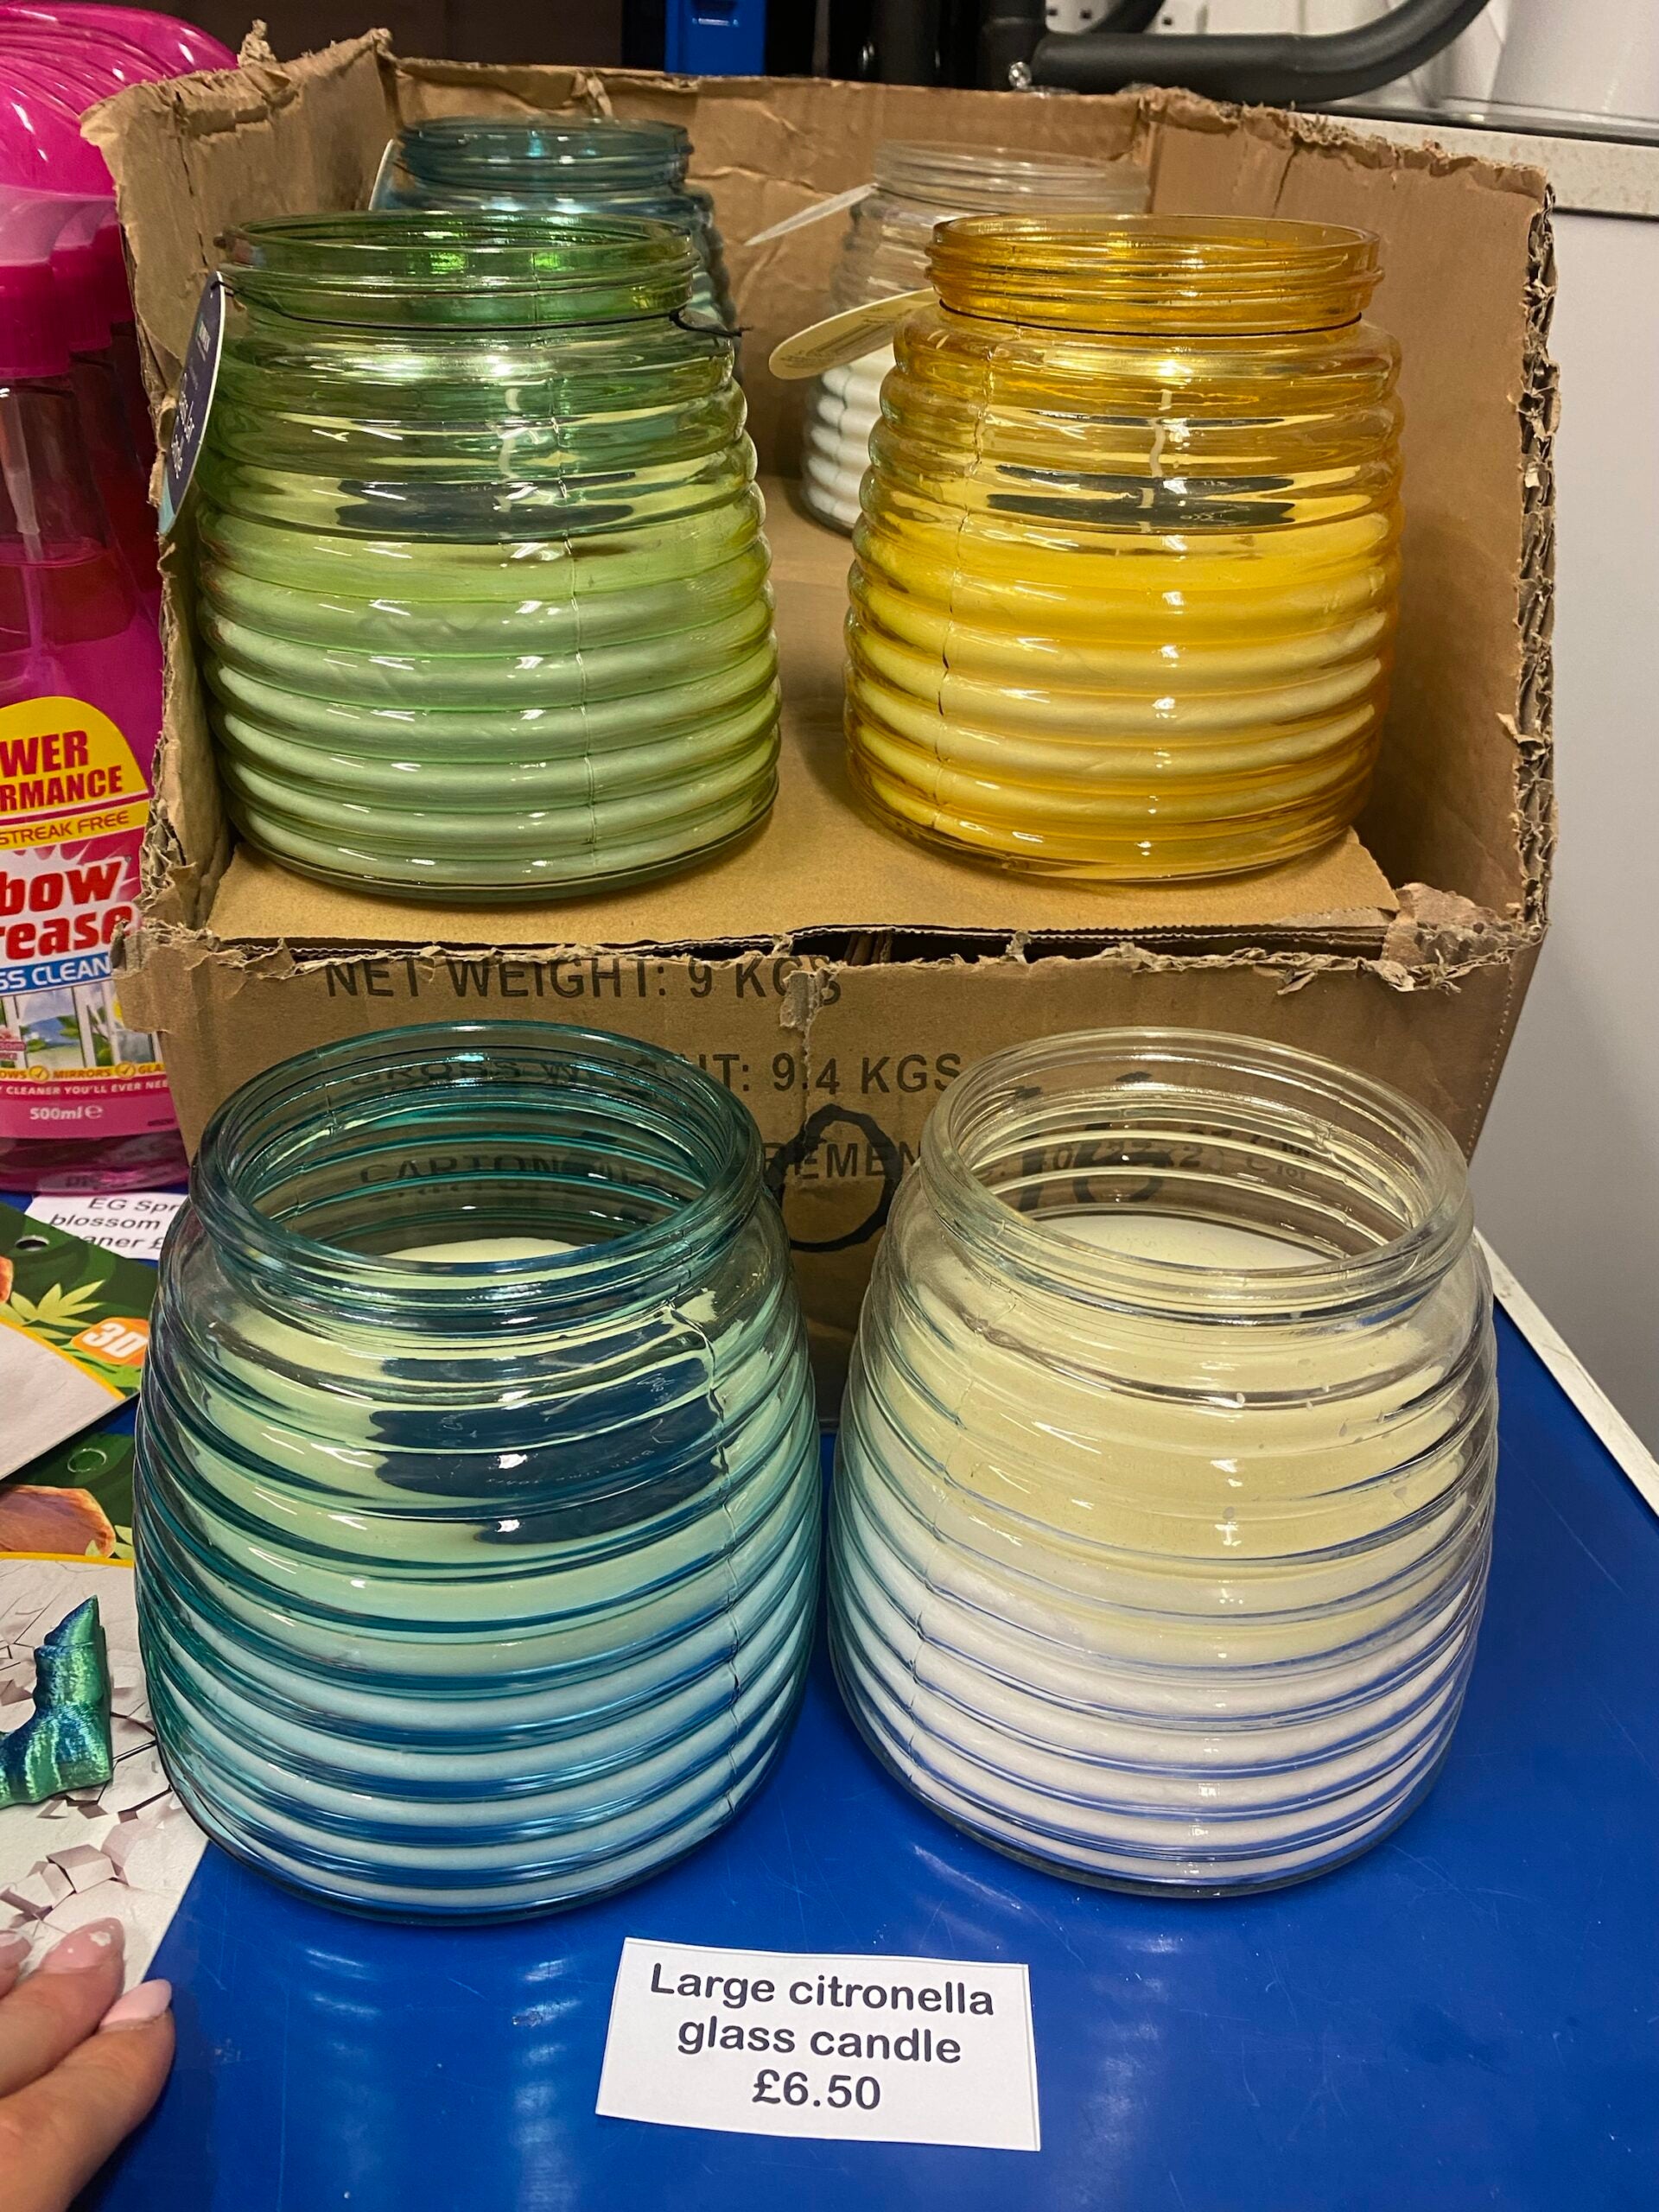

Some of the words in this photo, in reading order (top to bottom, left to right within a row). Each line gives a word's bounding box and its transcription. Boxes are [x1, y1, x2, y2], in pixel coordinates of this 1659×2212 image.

[77, 810, 130, 833] FREE
[445, 955, 666, 999] WEIGHT:
[688, 957, 712, 998] 9
[53, 1068, 111, 1079] MIRRORS
[772, 1052, 840, 1095] 9.4
[861, 1052, 961, 1093] KGS
[6, 1085, 61, 1096] CLEANER
[64, 1085, 107, 1095] YOU'LL
[111, 1082, 142, 1093] EVER
[29, 1105, 83, 1121] 500ml
[87, 1197, 128, 1211] EG
[48, 1213, 161, 1230] blossom
[82, 1322, 148, 1358] 3D
[650, 1962, 775, 2009] Large
[788, 1974, 994, 2016] citronella
[677, 2015, 796, 2055] glass
[810, 2028, 962, 2064] candle
[751, 2069, 881, 2111] £6.50
